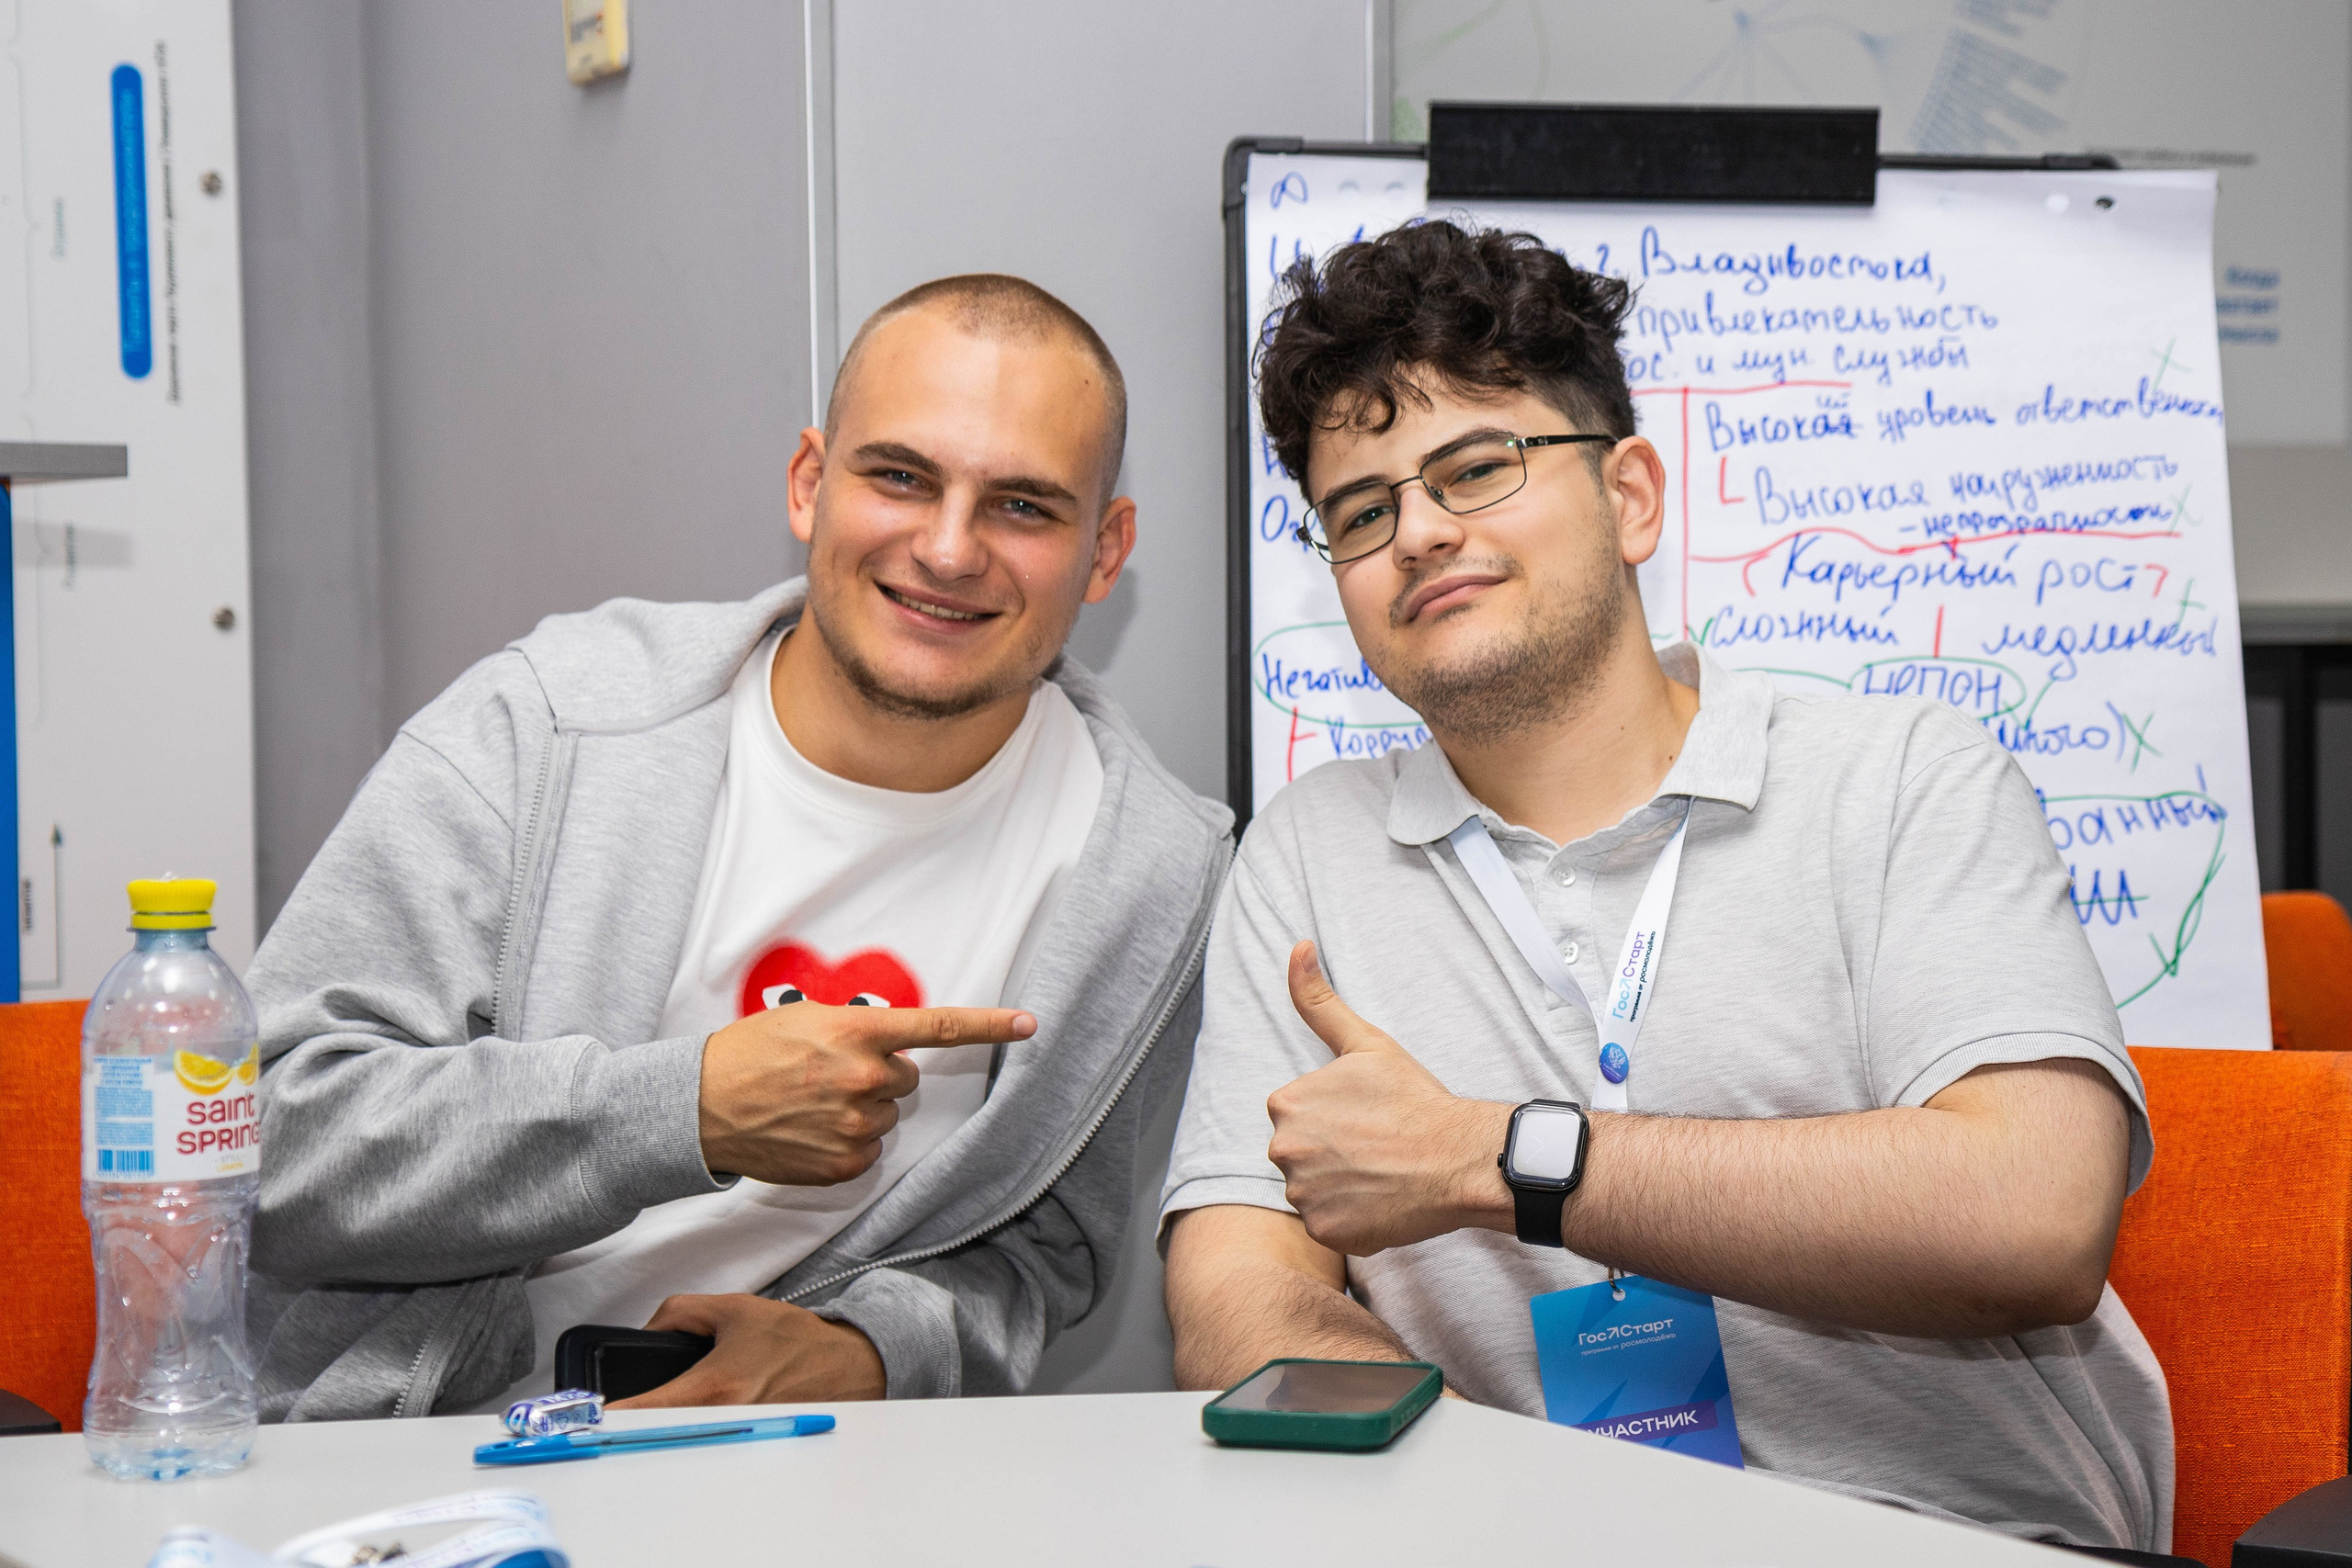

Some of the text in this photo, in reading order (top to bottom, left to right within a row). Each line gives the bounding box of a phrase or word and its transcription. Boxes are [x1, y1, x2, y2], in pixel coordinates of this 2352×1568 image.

[1641, 225, 1947, 296] Владивостока,
[1637, 290, 1999, 355] привлекательность
[1619, 349, 1680, 382] ос.
[1697, 352, 1716, 377] и
[1833, 336, 1971, 387] службы
[1878, 389, 1996, 445] уровень
[1755, 465, 1928, 526] Высокая
[1781, 531, 2021, 603] Карьерный
[1711, 604, 1901, 649] Сложный
